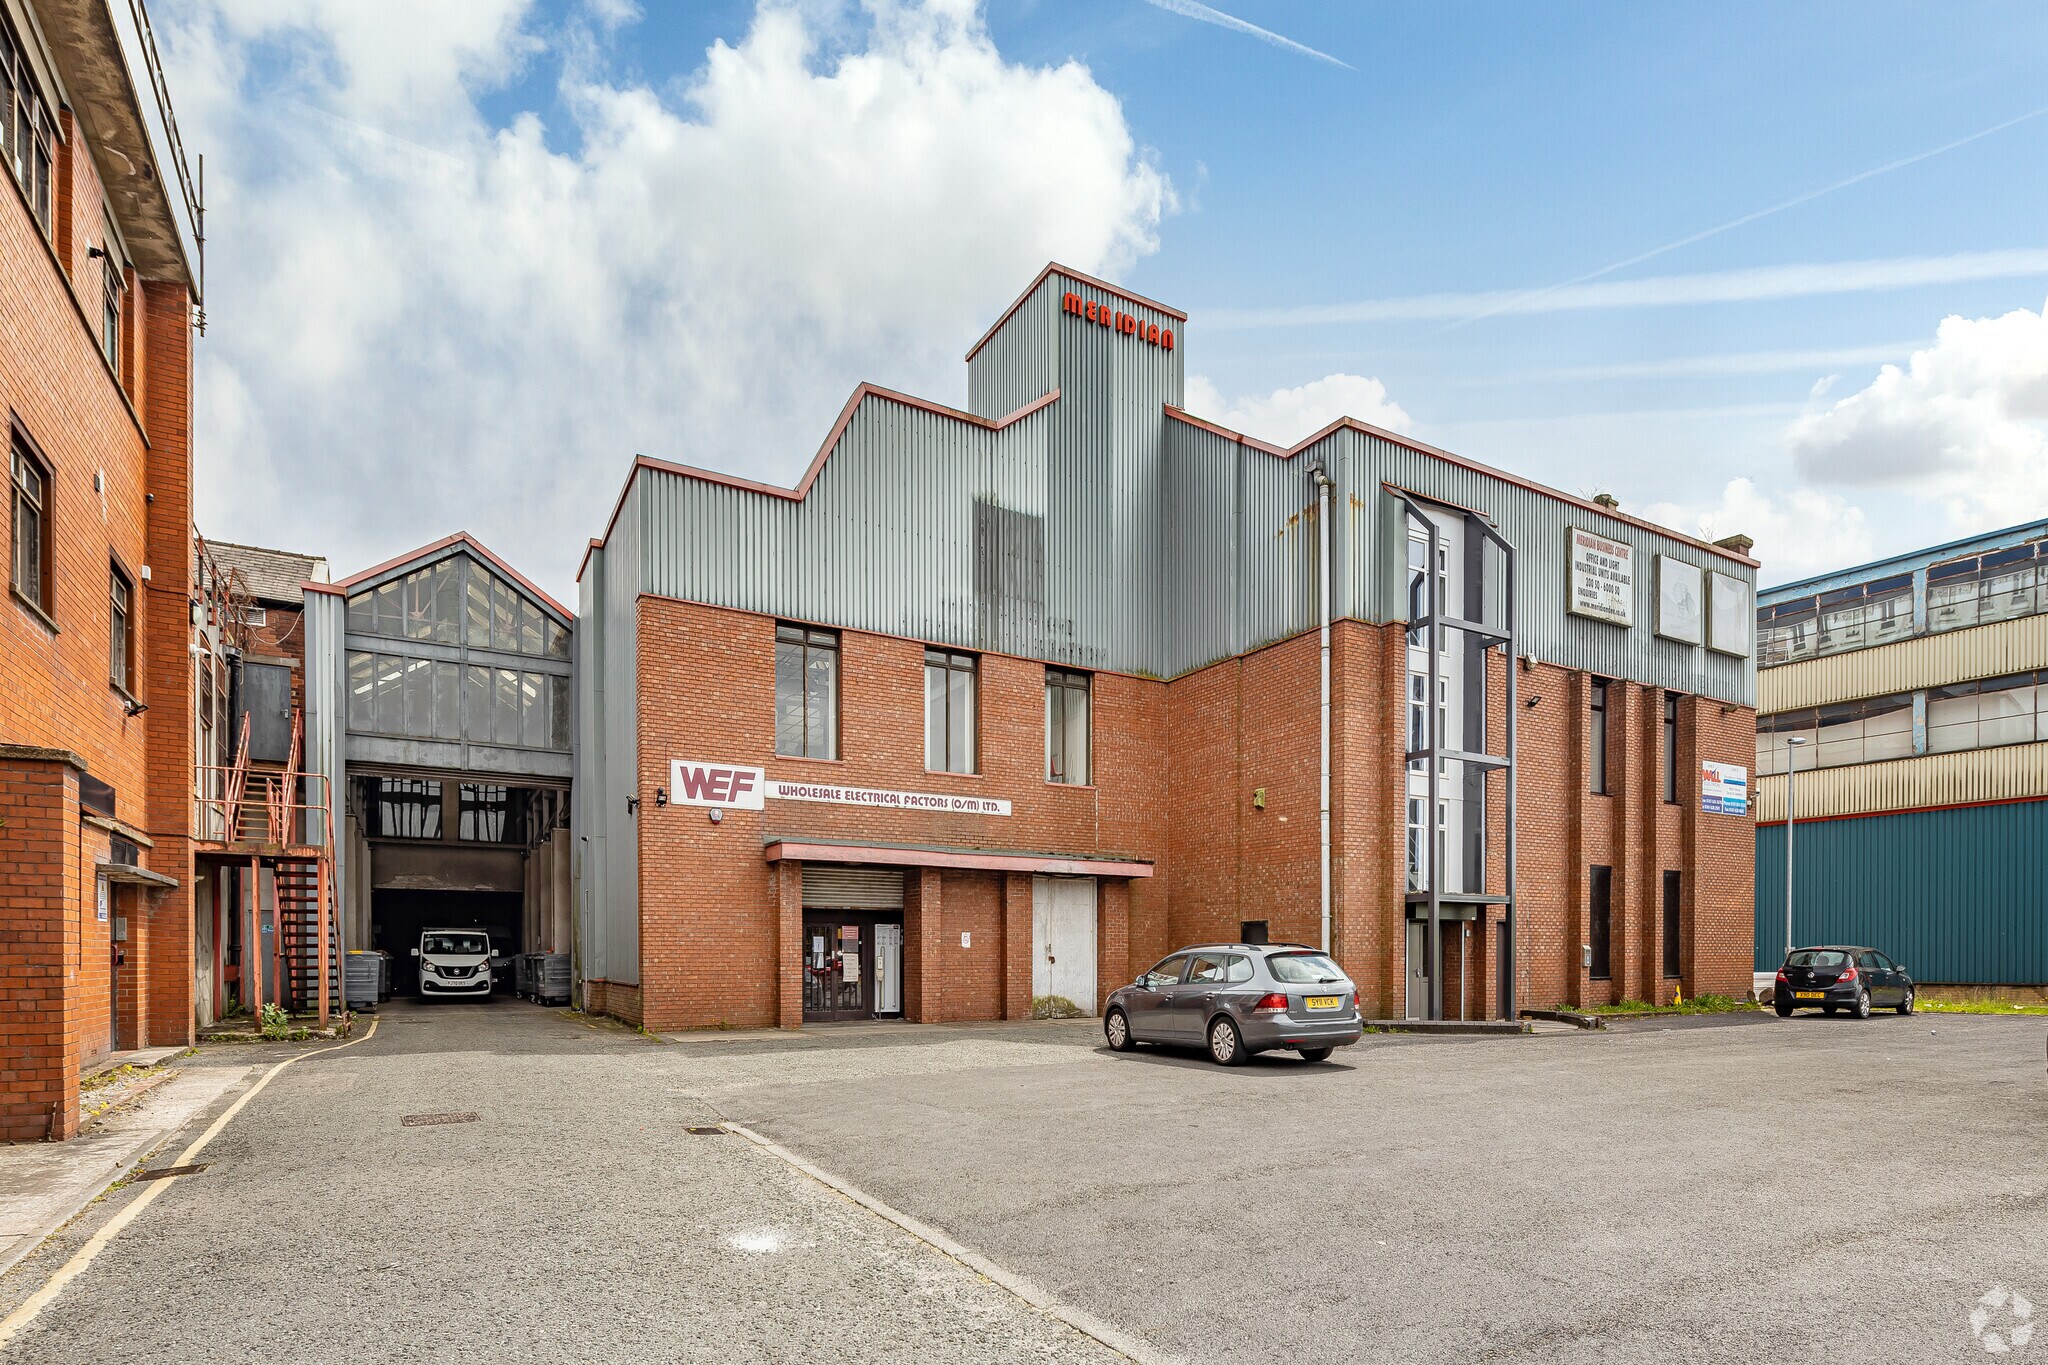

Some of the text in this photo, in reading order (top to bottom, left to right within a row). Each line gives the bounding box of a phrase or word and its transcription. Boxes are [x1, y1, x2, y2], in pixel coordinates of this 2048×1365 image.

[1063, 291, 1174, 351] MERIDIAN
[1576, 533, 1629, 560] MERIDIAN BUSINESS CENTRE
[1574, 560, 1631, 586] INDUSTRIAL UNITS AVAILABLE
[1585, 552, 1620, 571] OFFICE AND LIGHT
[1578, 586, 1598, 600] ENQUIRIES
[680, 766, 756, 802] WEF
[778, 784, 1001, 813] WHOLESALE ELECTRICAL FACTORS (O/M) LTD.
